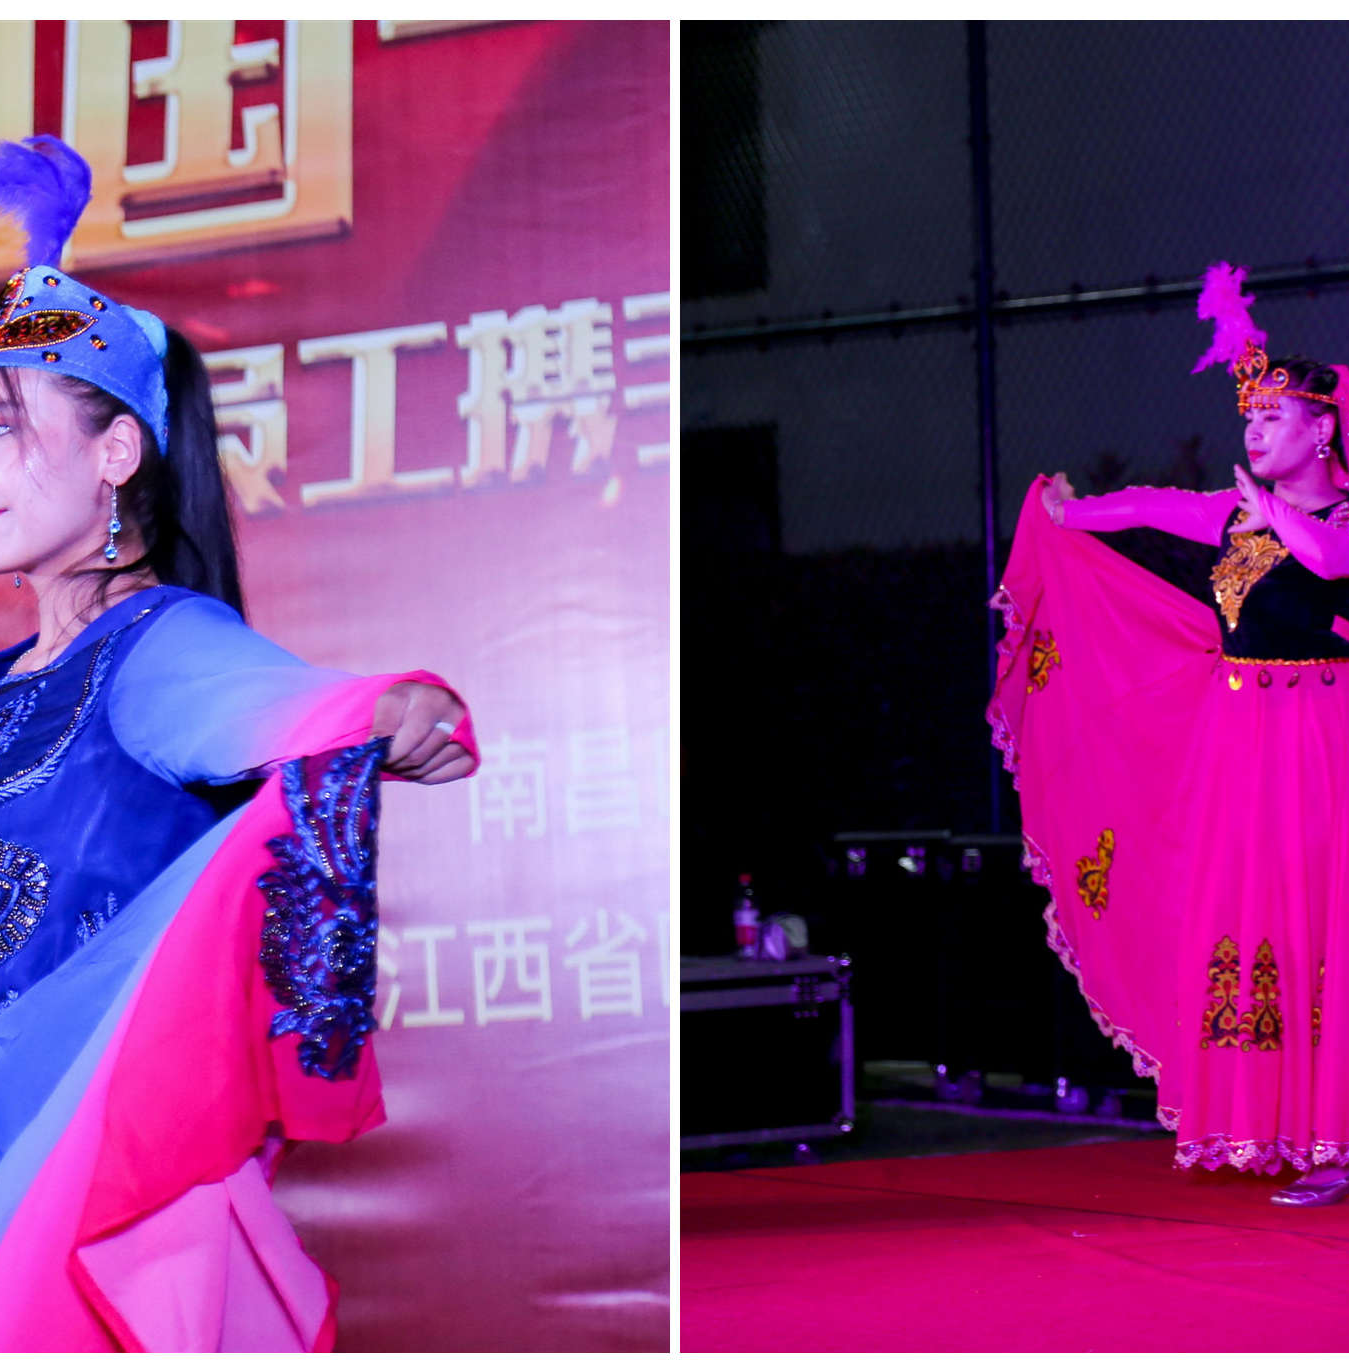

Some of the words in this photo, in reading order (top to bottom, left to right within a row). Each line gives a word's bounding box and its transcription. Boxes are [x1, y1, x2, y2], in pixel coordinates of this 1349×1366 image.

[467, 727, 670, 844] 南昌
[377, 908, 670, 1031] 江西省
